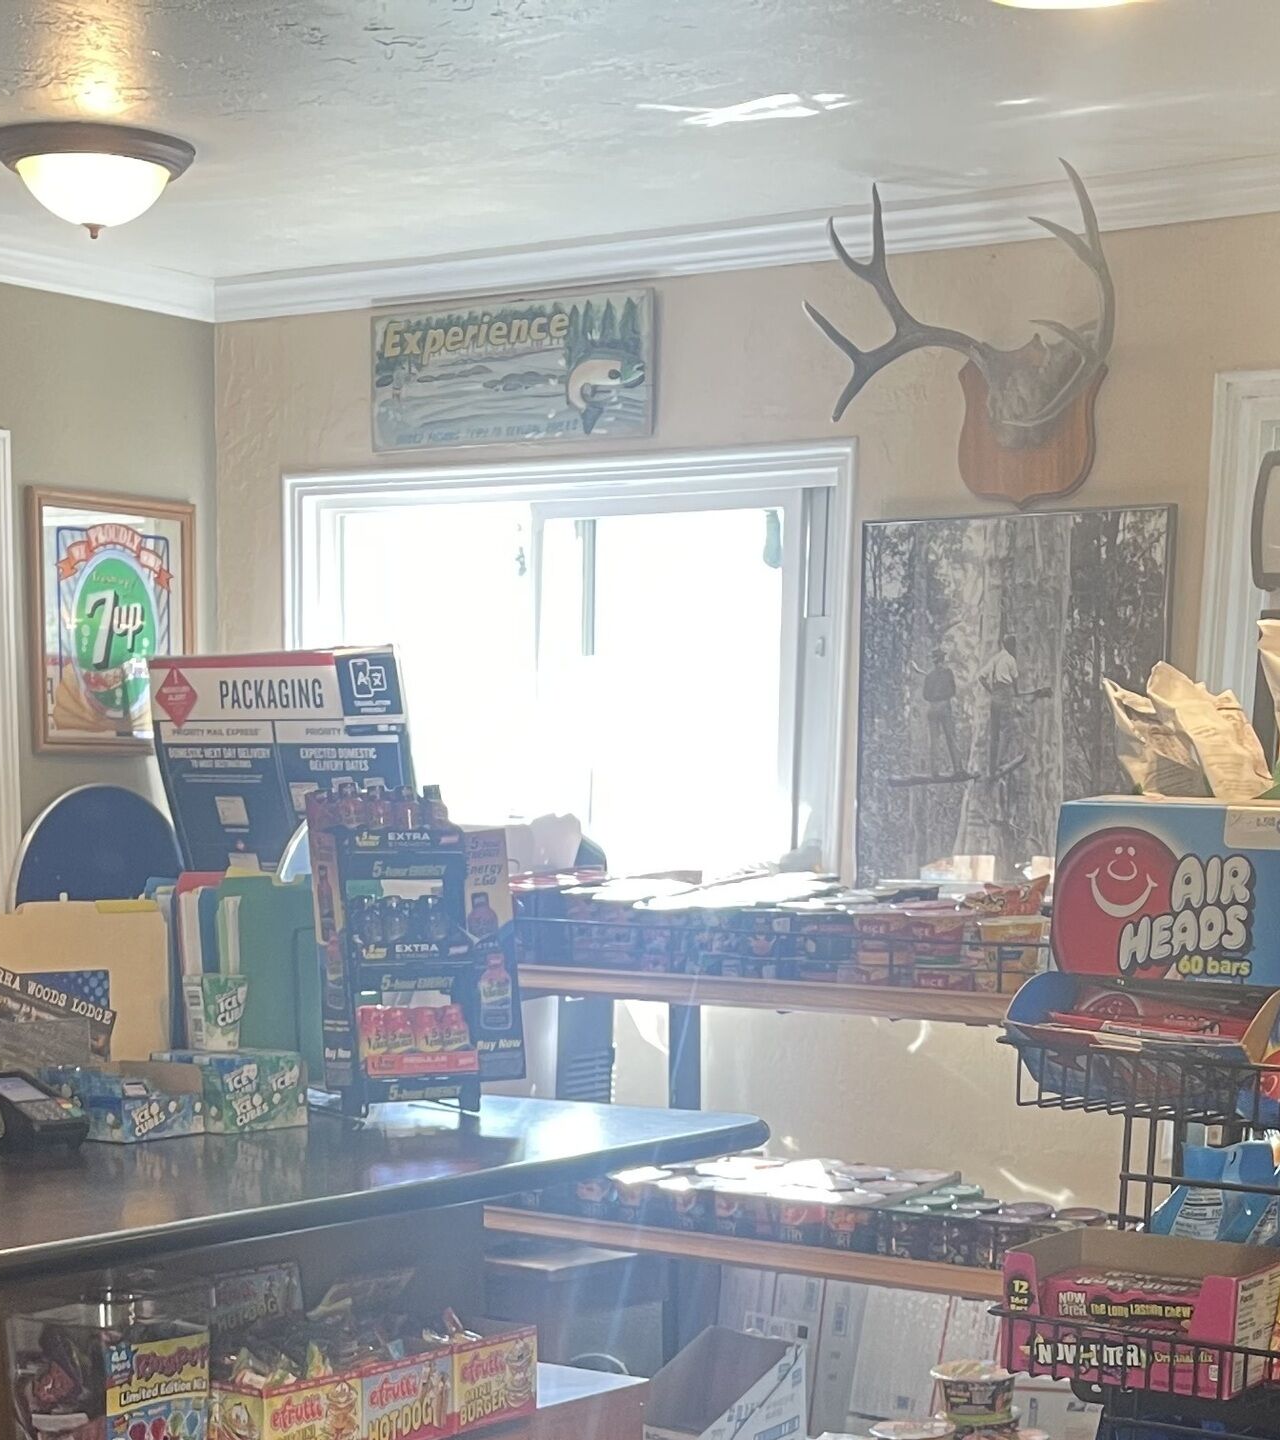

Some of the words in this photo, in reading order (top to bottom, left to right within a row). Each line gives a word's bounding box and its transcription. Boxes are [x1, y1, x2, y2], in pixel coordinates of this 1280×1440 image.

[383, 312, 569, 365] Experience
[219, 677, 325, 710] PACKAGING
[387, 831, 431, 841] EXTRA
[1171, 853, 1252, 913] AIR
[395, 943, 440, 953] EXTRA
[1118, 905, 1251, 972] HEADS
[1176, 955, 1204, 977] 60
[1205, 956, 1251, 977] bars
[27, 979, 67, 1009] WOODS
[71, 994, 114, 1025] LODGE
[1012, 1279, 1029, 1294] 12
[1058, 1290, 1087, 1305] NOW
[120, 1386, 158, 1407] Limited
[159, 1381, 191, 1398] Edition
[459, 1389, 507, 1427] BURGER
